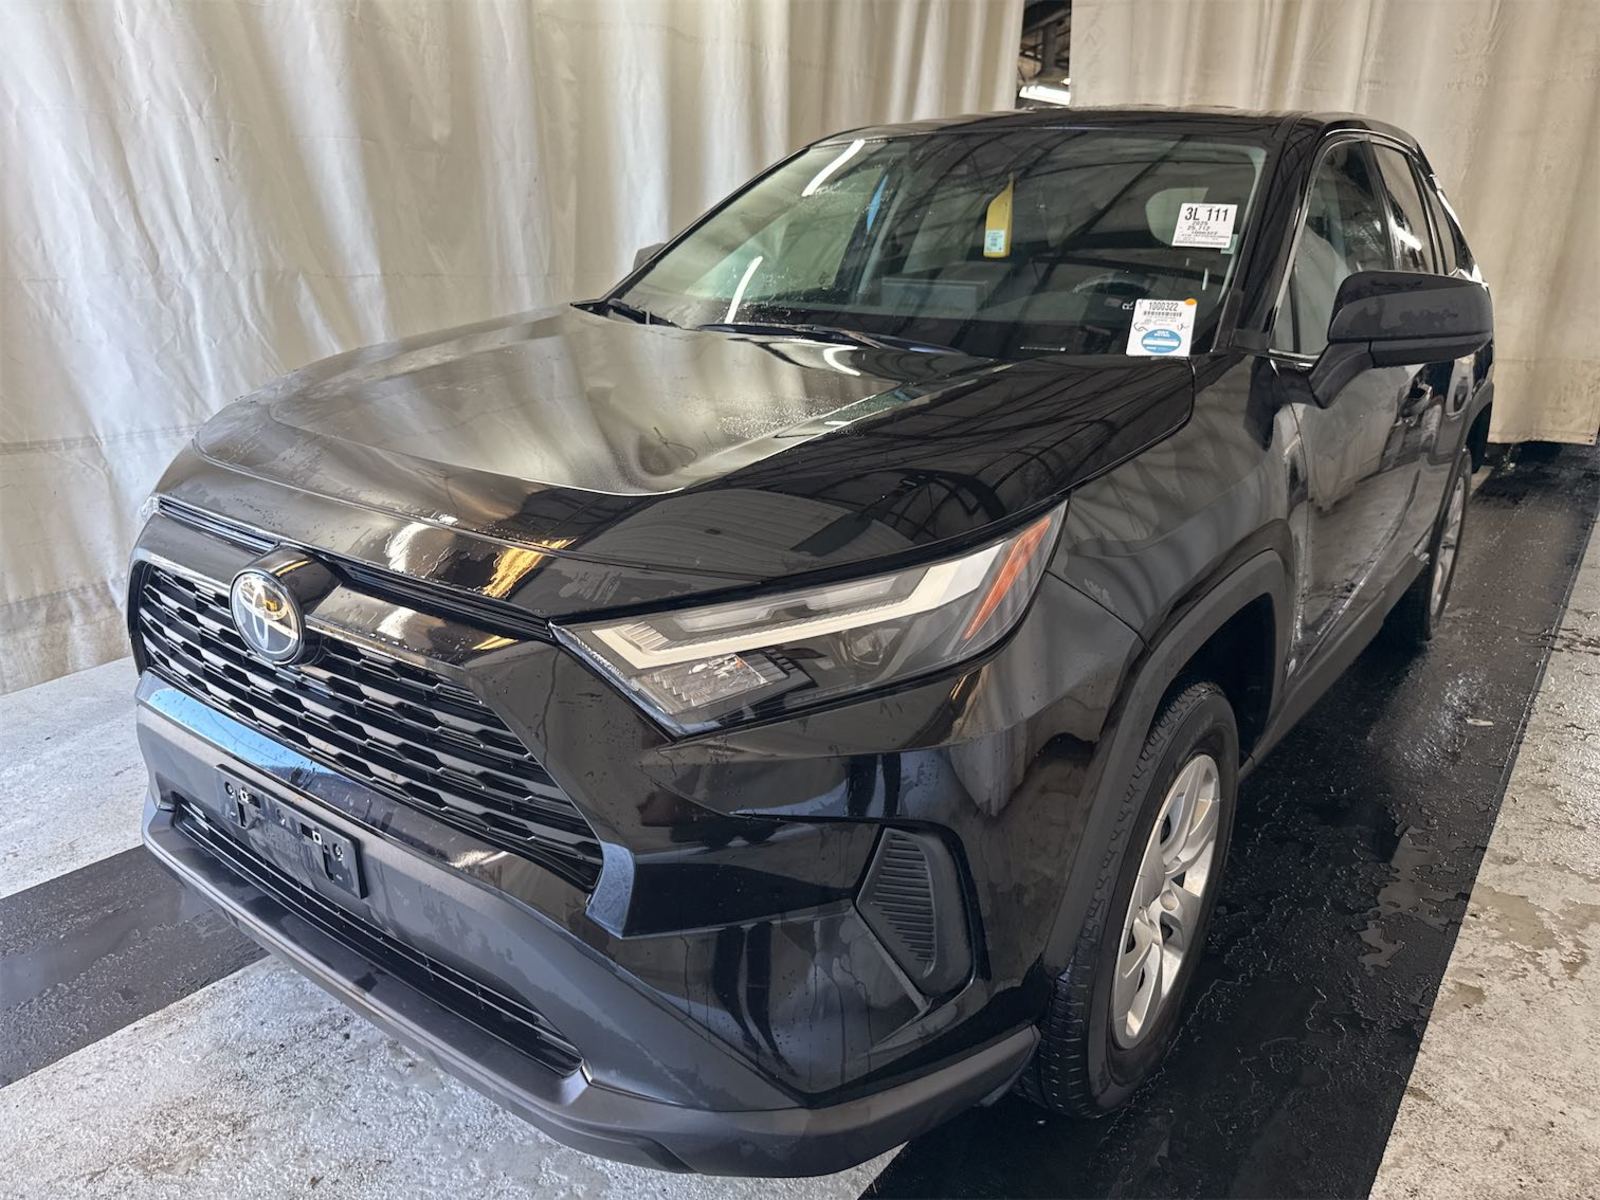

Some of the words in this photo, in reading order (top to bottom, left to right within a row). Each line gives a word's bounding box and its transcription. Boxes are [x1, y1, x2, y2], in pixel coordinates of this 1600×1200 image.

[1185, 206, 1200, 221] 3L
[1207, 208, 1229, 222] 111
[1149, 302, 1179, 311] 1000322
